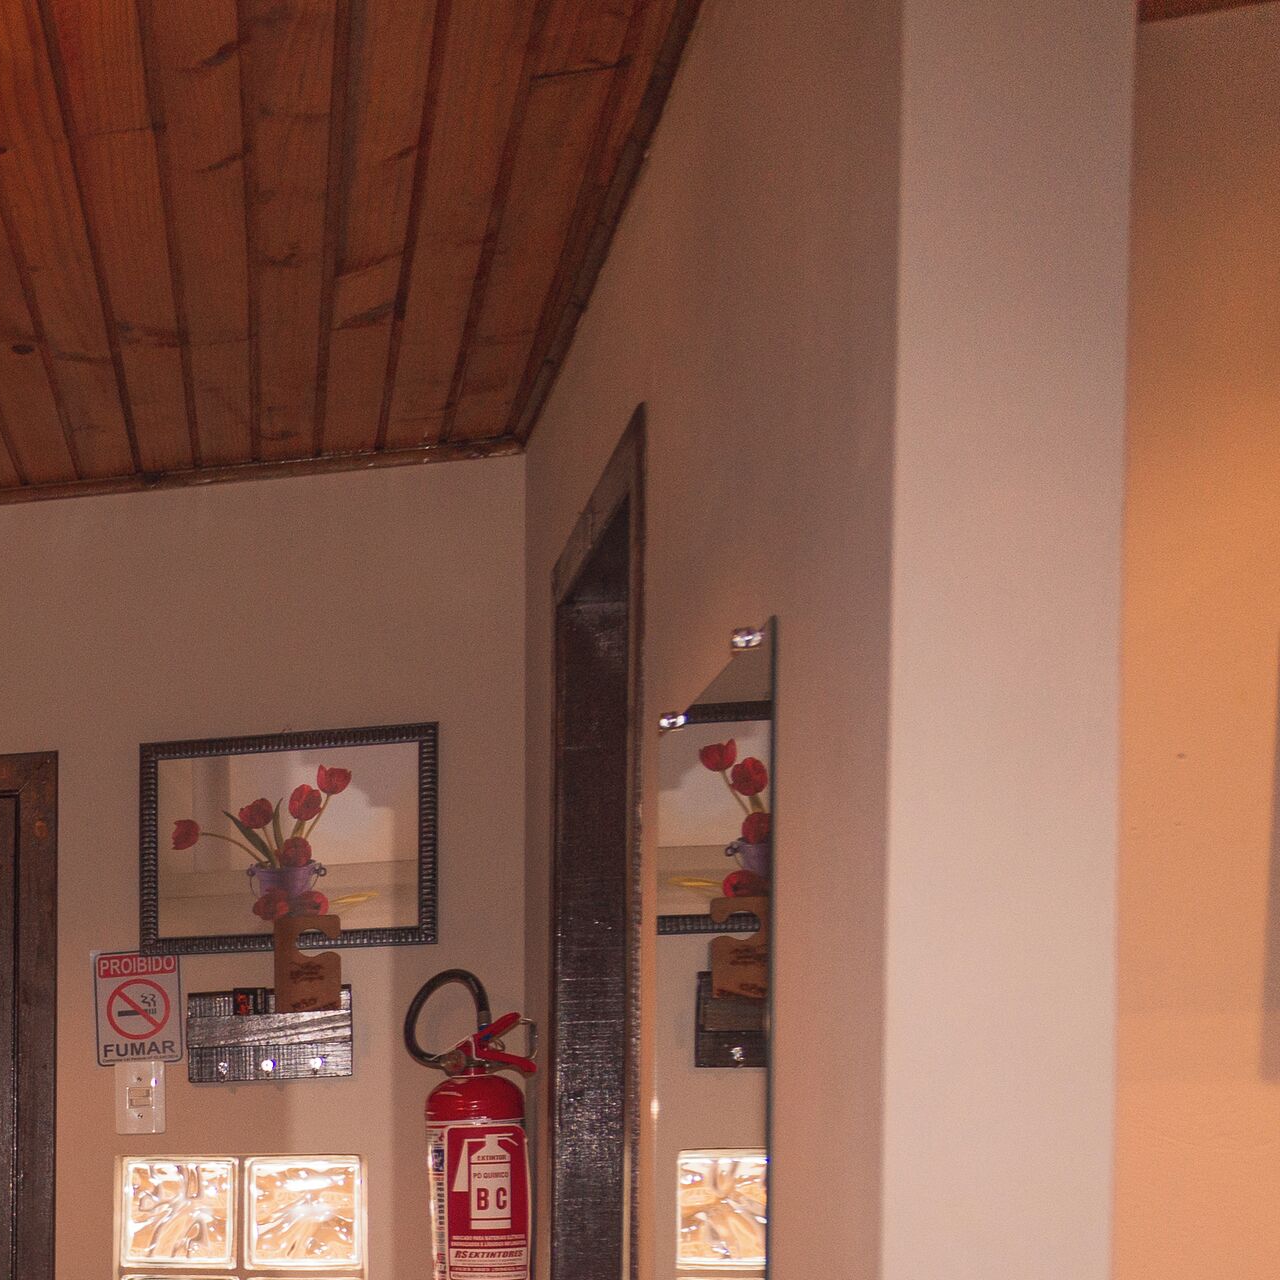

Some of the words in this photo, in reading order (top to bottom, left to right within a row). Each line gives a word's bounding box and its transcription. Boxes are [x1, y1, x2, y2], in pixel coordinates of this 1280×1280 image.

[99, 956, 175, 976] PROIBIDO
[103, 1040, 176, 1058] FUMAR
[476, 1187, 489, 1211] B
[496, 1186, 507, 1210] C
[454, 1250, 468, 1259] RS
[468, 1249, 524, 1259] EXTINTORES
